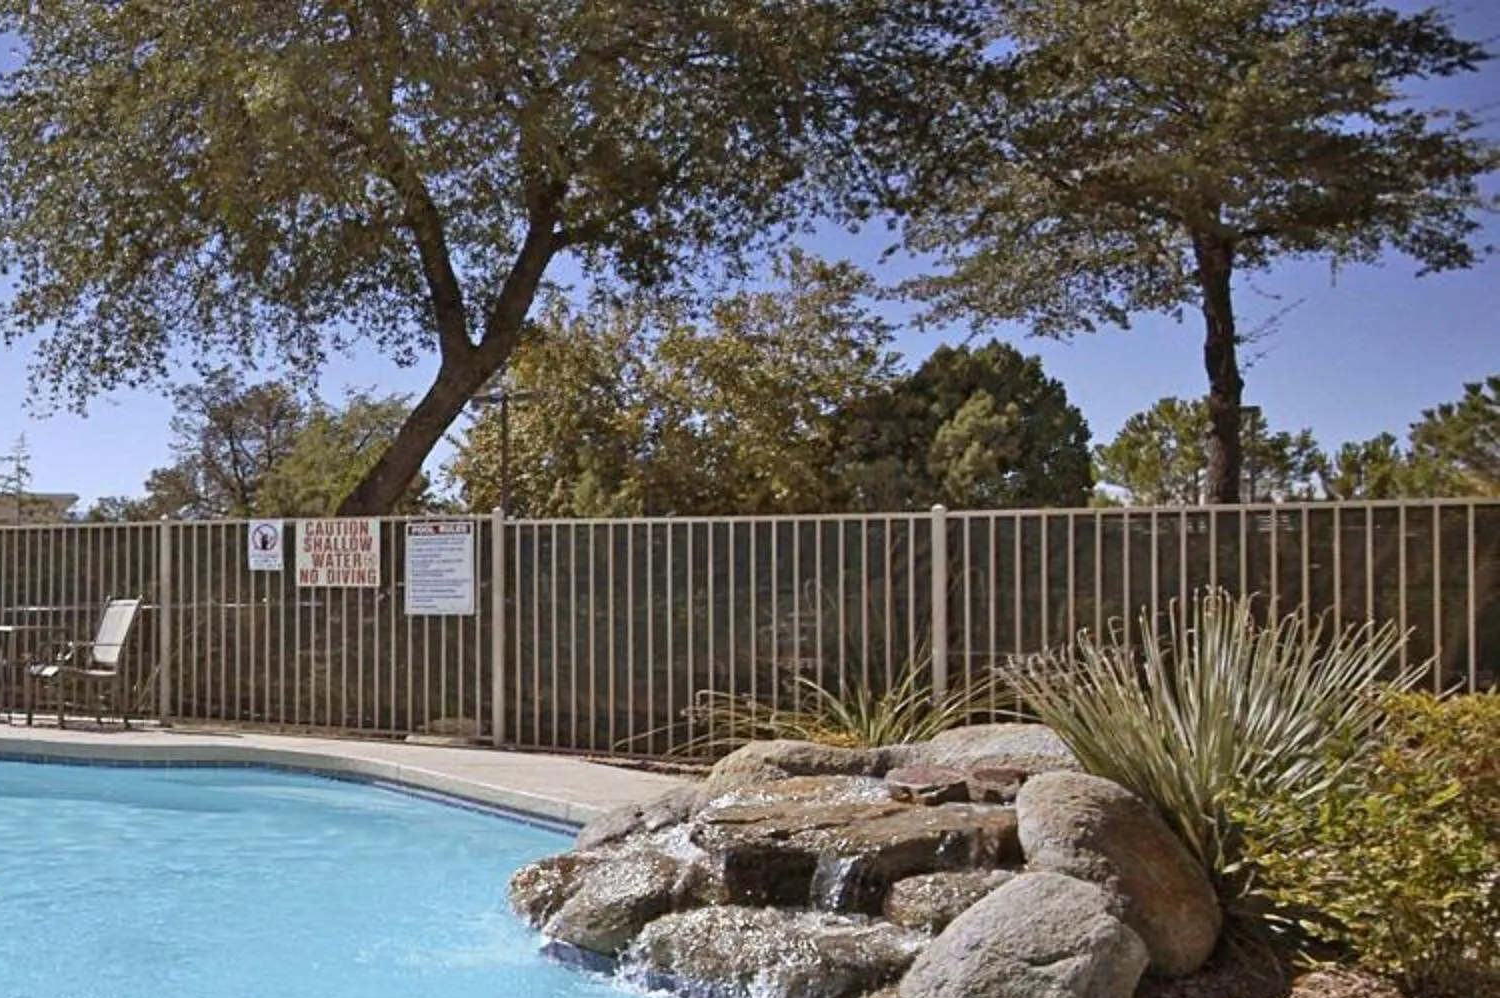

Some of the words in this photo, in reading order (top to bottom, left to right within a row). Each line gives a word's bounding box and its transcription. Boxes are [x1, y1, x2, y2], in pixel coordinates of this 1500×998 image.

[305, 521, 369, 536] CAUTION
[304, 536, 372, 552] SHALLOW
[311, 553, 362, 568] WATER
[300, 569, 318, 584] NO
[328, 569, 377, 584] DIVING
